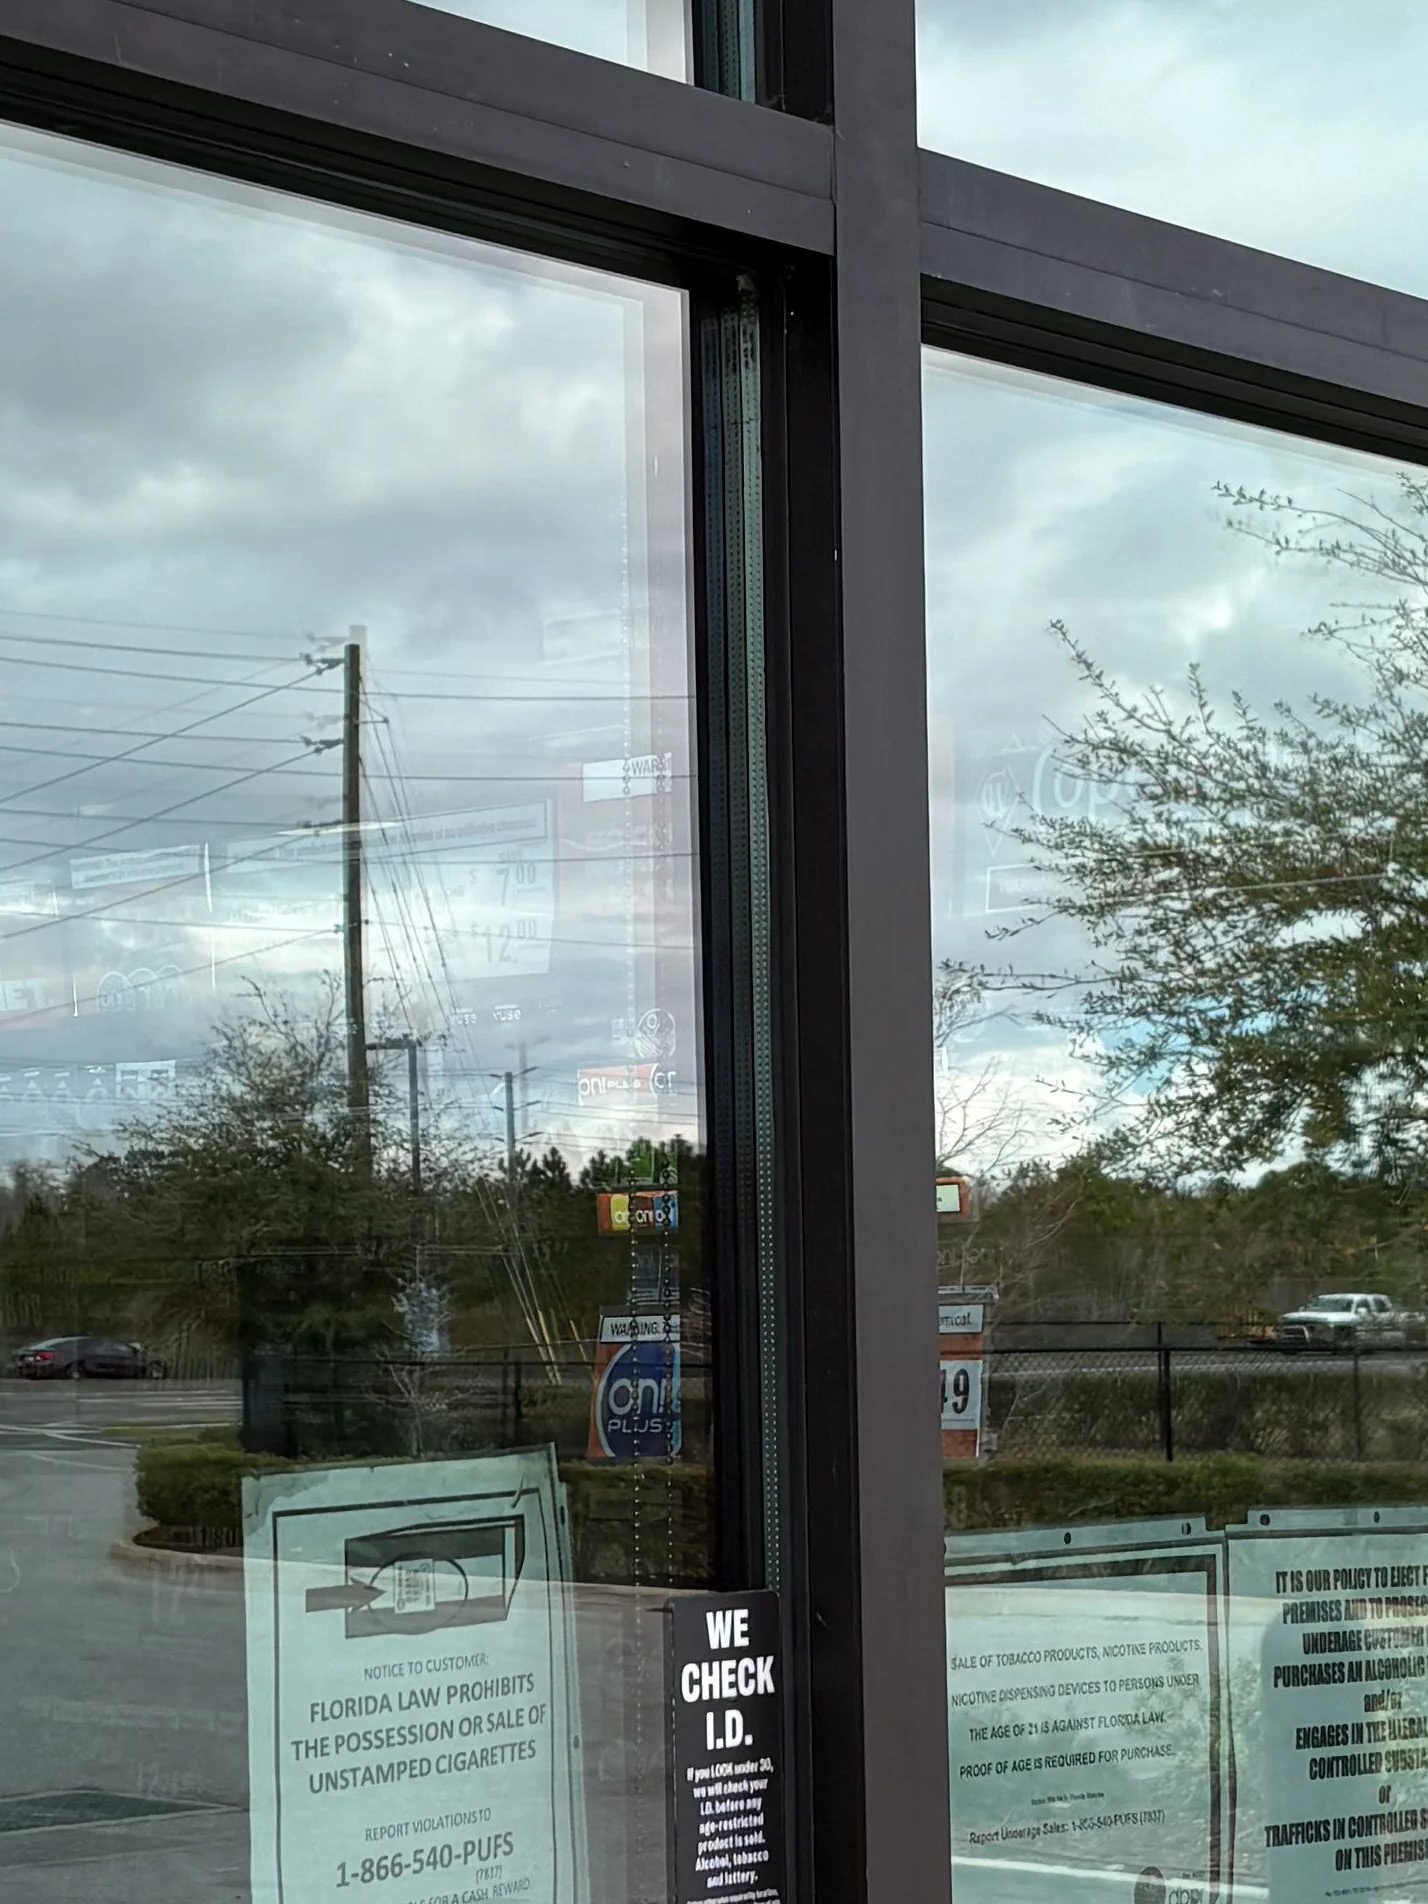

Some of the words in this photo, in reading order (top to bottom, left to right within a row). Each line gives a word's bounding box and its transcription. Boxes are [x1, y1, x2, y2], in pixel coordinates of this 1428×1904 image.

[608, 1417, 663, 1433] PLUS
[1275, 1570, 1289, 1594] IT
[1290, 1569, 1303, 1593] IS
[1305, 1568, 1331, 1593] OUR
[1333, 1566, 1372, 1591] POLICY
[1374, 1565, 1389, 1588] TO
[1390, 1564, 1421, 1588] EJECT
[1282, 1599, 1343, 1625] PREMISES
[1344, 1597, 1368, 1621] AND
[1368, 1596, 1384, 1619] TO
[705, 1608, 750, 1650] WE
[1302, 1629, 1363, 1655] UNDERAGE
[364, 1662, 405, 1681] NOTICE
[407, 1659, 423, 1675] TO
[425, 1652, 490, 1673] CUSTOMER:
[681, 1655, 776, 1703] CHECK
[1273, 1662, 1346, 1688] PURCHASES
[1347, 1660, 1364, 1683] AN
[1364, 1655, 1425, 1681] ALCOHOLIC
[309, 1693, 393, 1723] FLORIDA
[397, 1686, 440, 1712] LAW
[446, 1672, 535, 1706] PROHIBITS
[1363, 1690, 1404, 1714] and/or
[290, 1736, 331, 1761] THE
[333, 1718, 455, 1755] POSSESSION
[457, 1712, 484, 1733] OR
[486, 1707, 525, 1733] SALE
[528, 1702, 547, 1725] OF
[706, 1708, 754, 1751] I.D.
[1295, 1723, 1350, 1750] ENGAGES
[1350, 1721, 1365, 1745] IN
[1365, 1719, 1388, 1744] THE
[1387, 1716, 1428, 1742] ILLEGAL
[308, 1759, 432, 1794] UNSTAMPED
[435, 1739, 537, 1776] CIGARETTES
[959, 1762, 994, 1779] PROOF
[995, 1760, 1009, 1775] OF
[1011, 1757, 1033, 1773] AGE
[1033, 1756, 1043, 1770] IS
[1044, 1750, 1096, 1770] REQUIRED
[1097, 1747, 1119, 1764] FOR
[1308, 1751, 1383, 1781] CONTROLLED
[364, 1821, 410, 1842] REPORT
[412, 1809, 478, 1834] VIOLATIONS
[479, 1807, 492, 1823] TO
[699, 1813, 765, 1837] age-restricted
[1264, 1817, 1331, 1848] TRAFFICKS
[1332, 1816, 1347, 1841] IN
[1347, 1808, 1419, 1838] CONTROLLED
[335, 1831, 515, 1889] 1-866-540-PUFS
[1334, 1848, 1353, 1872] ON
[1353, 1843, 1383, 1869] THIS
